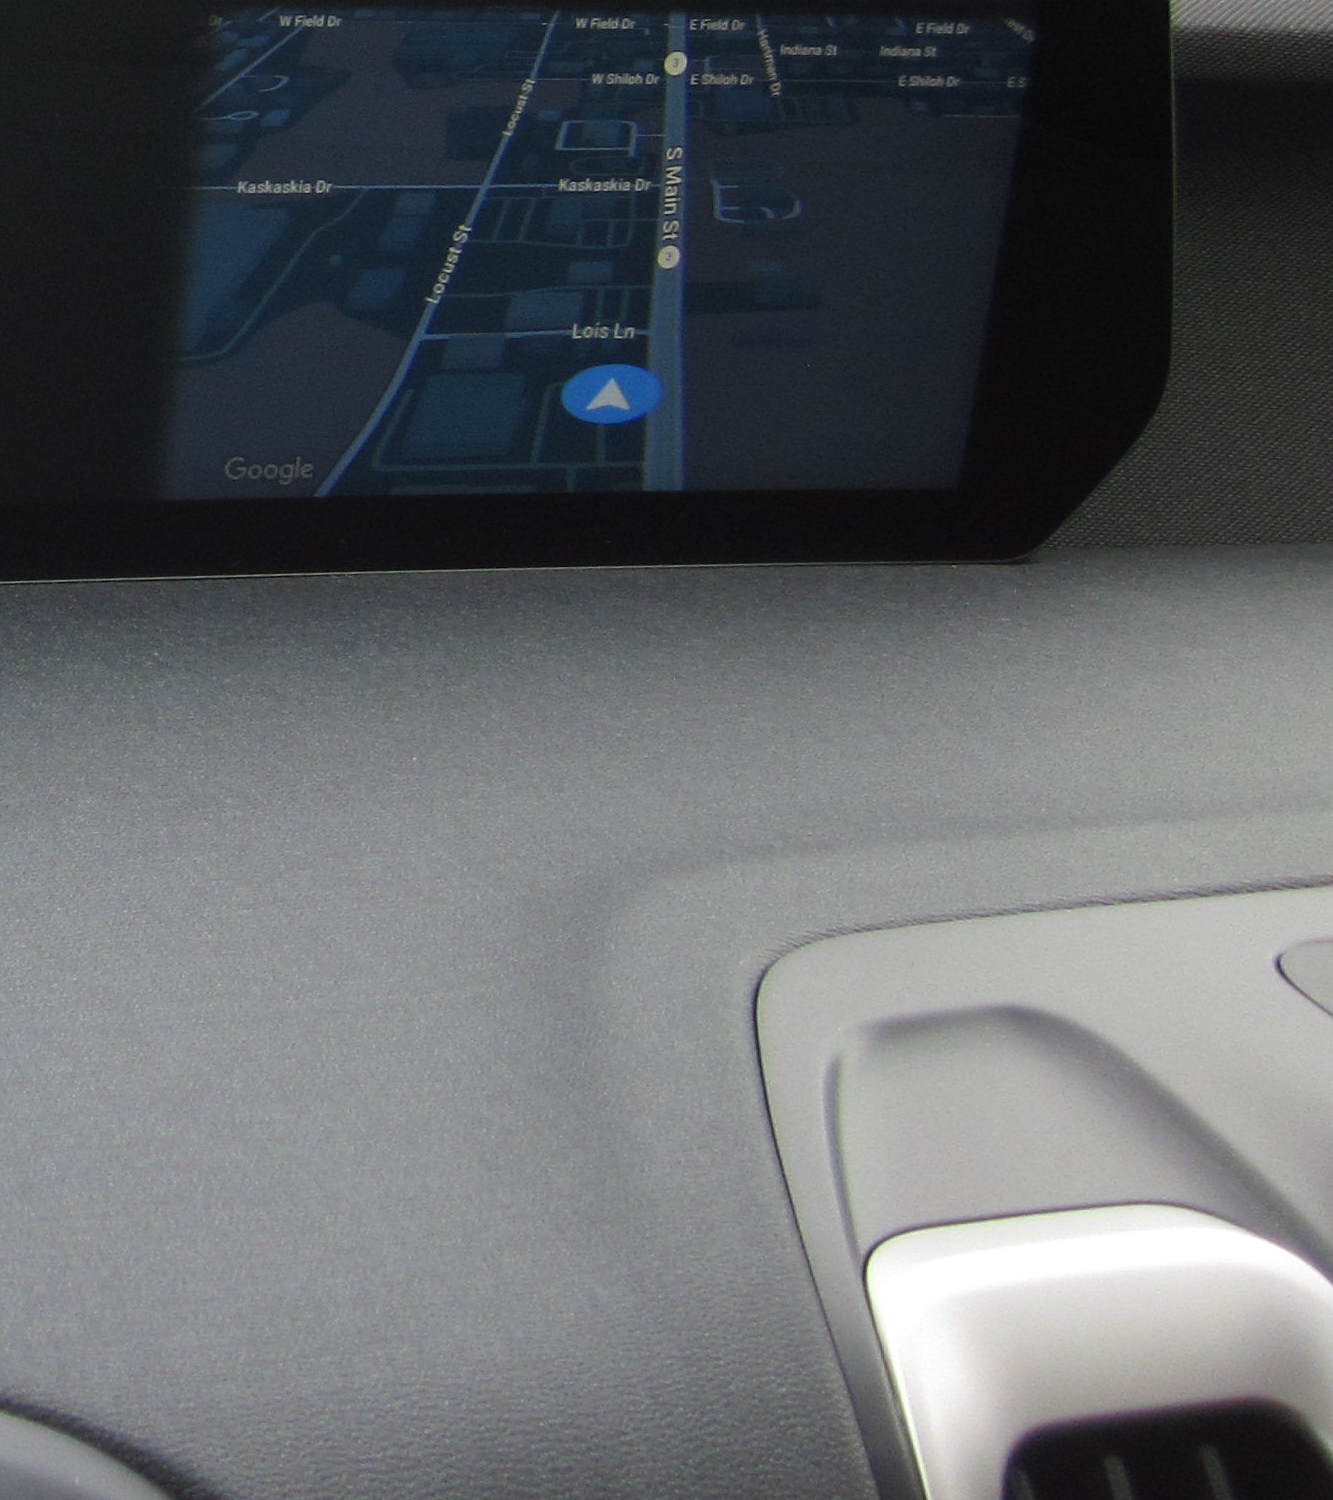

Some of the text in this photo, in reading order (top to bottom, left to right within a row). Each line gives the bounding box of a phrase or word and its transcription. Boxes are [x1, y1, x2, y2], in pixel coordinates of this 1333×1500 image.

[279, 14, 342, 28] W Field Dr
[576, 16, 636, 30] W Field Dr
[689, 18, 746, 32] E Field Dr
[916, 22, 970, 36] E Field Dr
[780, 43, 838, 57] Indiana St
[879, 45, 937, 58] Indiana St
[592, 72, 660, 86] W Shiloh Dr
[690, 73, 754, 87] E Shiloh Dr
[898, 75, 961, 88] E Shiloh Dr
[1007, 75, 1016, 88] E
[501, 77, 536, 138] Locust St
[236, 180, 333, 195] Kaskaskia Dr
[558, 177, 652, 193] Kaskaskia Dr
[661, 146, 683, 241] S Main St
[425, 223, 473, 304] Locust St
[571, 322, 636, 340] Lois Ln
[224, 455, 314, 485] Google
